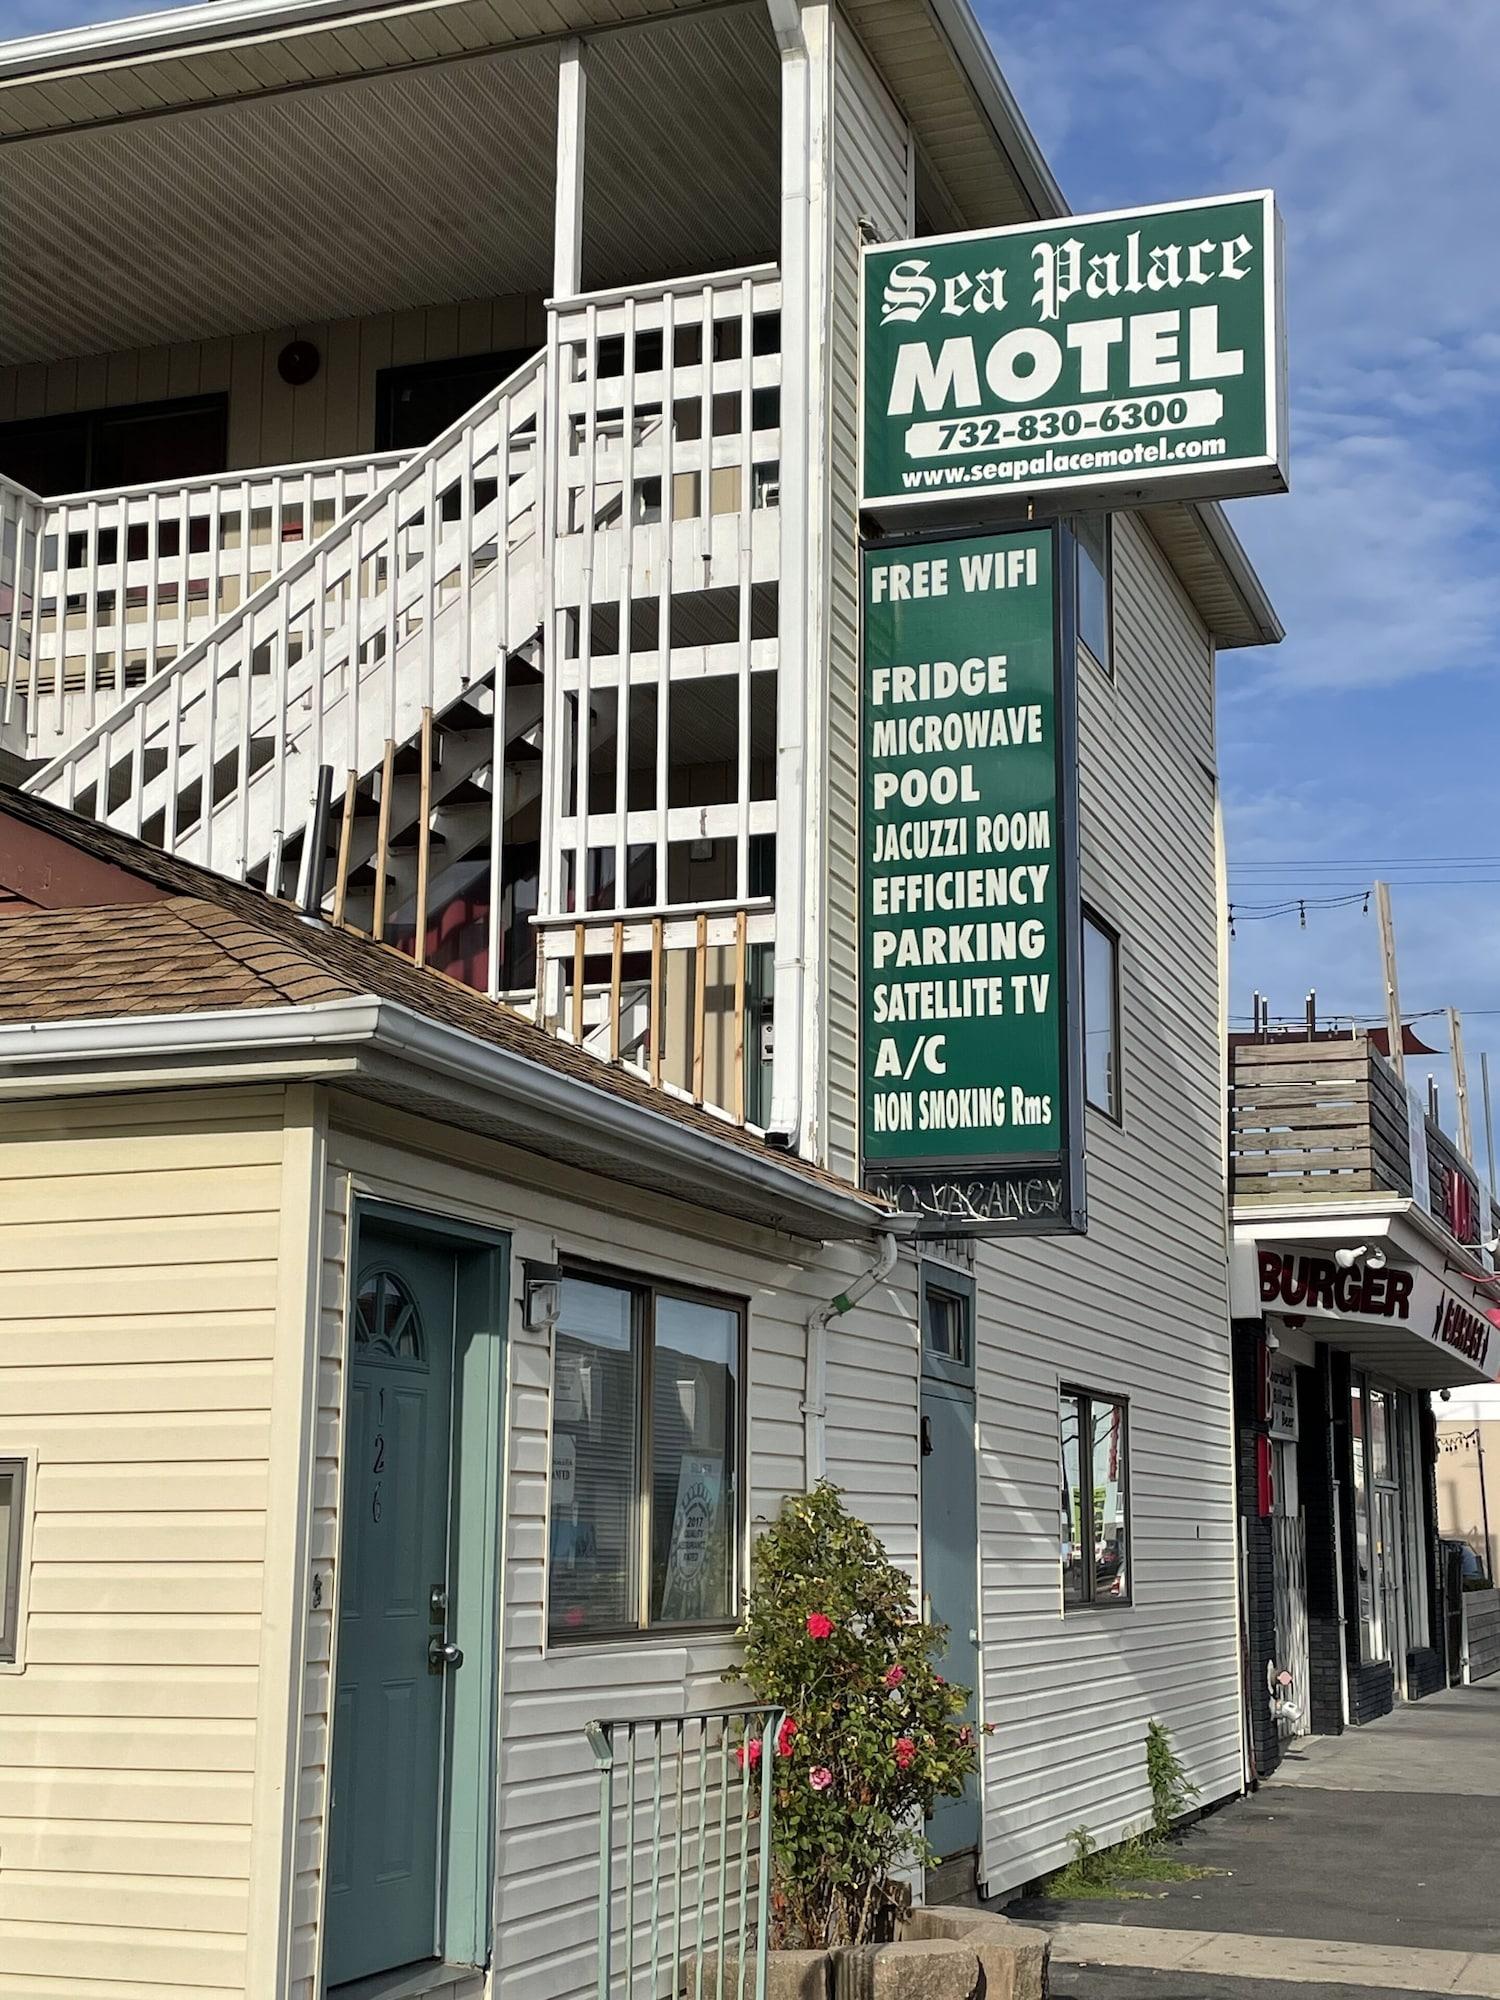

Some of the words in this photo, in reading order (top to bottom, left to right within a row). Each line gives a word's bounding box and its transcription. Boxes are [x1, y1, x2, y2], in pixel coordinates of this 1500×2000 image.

[880, 260, 1008, 326] Sea
[1031, 231, 1254, 323] Palace
[887, 305, 1244, 416] MOTEL
[938, 398, 1188, 451] 732-830-6300
[902, 437, 1226, 488] www.seapalacemotel.com
[872, 559, 947, 603] FREE
[960, 549, 1036, 592] WIFI
[873, 656, 1006, 705] FRIDGE
[873, 705, 1042, 757] MICROWAVE
[874, 765, 979, 809] POOL
[873, 818, 966, 862] JACUZZI
[977, 811, 1049, 853] ROOM
[873, 865, 1049, 915] EFFICIENCY
[874, 920, 1044, 968] PARKING
[874, 978, 1002, 1023] SATELLITE
[1011, 975, 1049, 1013] TV
[875, 1035, 945, 1079] A/C
[874, 1092, 912, 1131] NON
[919, 1087, 1005, 1130] SMOKING
[1012, 1087, 1051, 1125] Rms
[931, 1178, 1063, 1217] VACANCY
[1258, 1251, 1413, 1319] BURGER
